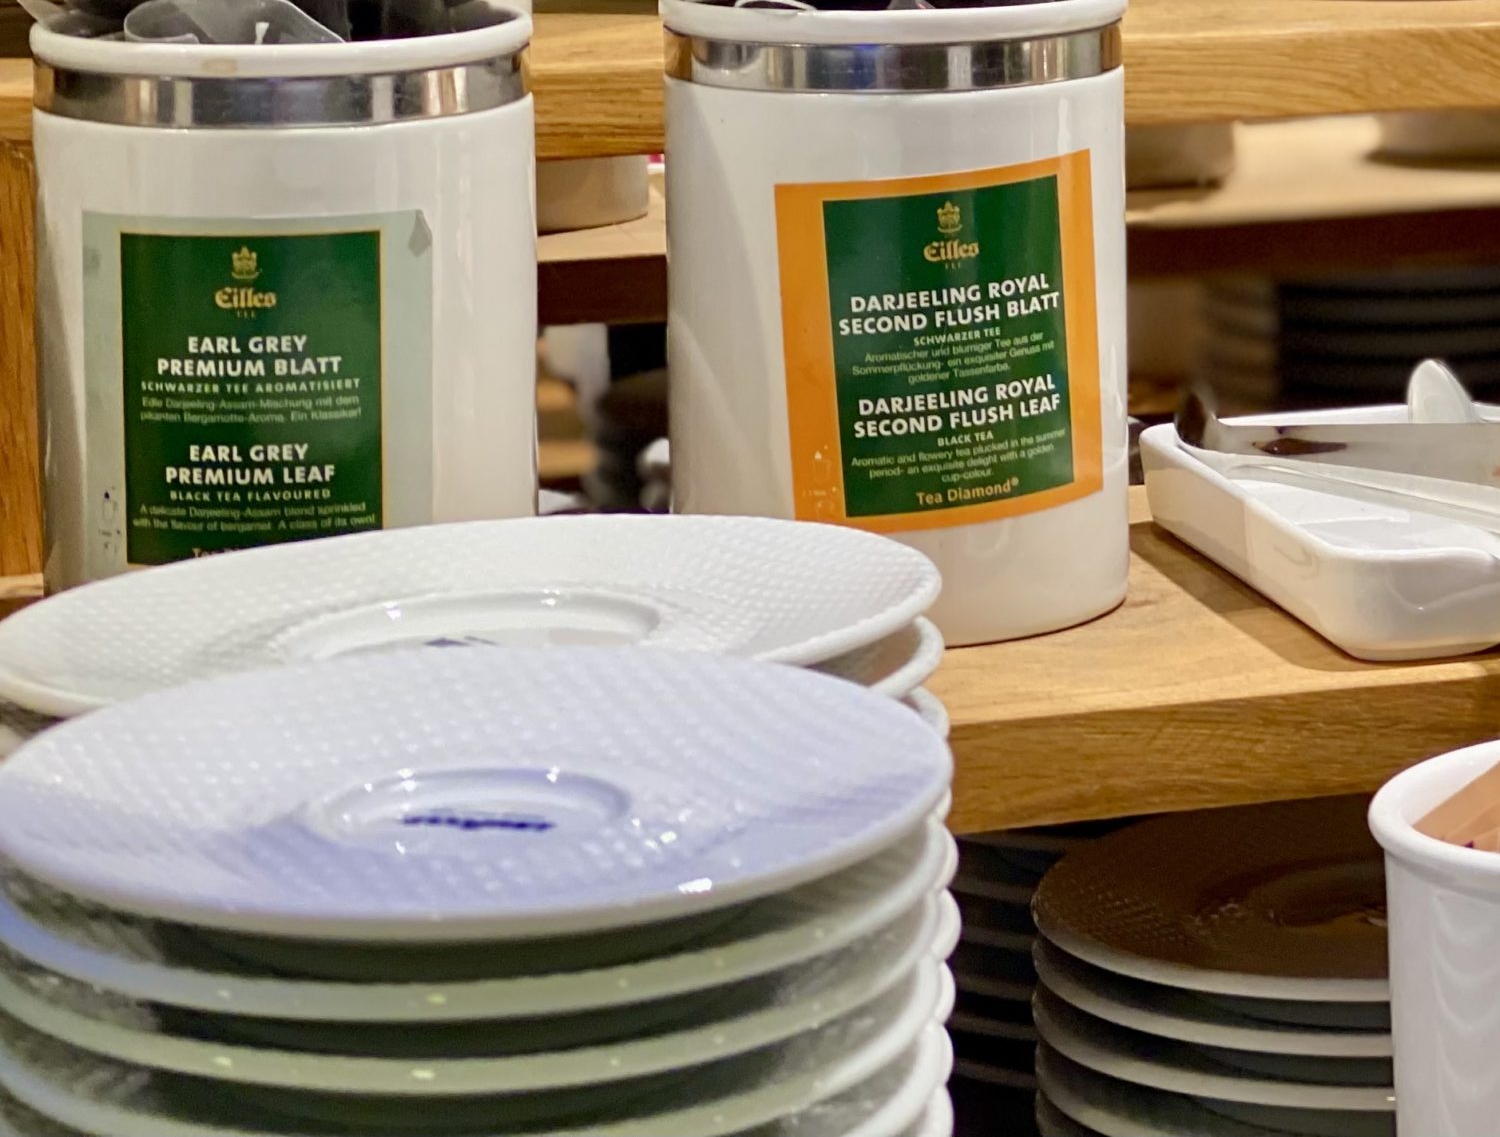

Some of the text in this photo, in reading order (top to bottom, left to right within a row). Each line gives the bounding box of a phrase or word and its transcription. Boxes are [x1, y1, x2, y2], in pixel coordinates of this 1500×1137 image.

[923, 239, 980, 262] Eilles
[214, 287, 277, 309] Eilles
[850, 273, 1049, 313] DARJEELING ROYAL
[839, 292, 1060, 336] SECOND FLUSH BLATT
[187, 334, 308, 354] EARL GREY
[913, 327, 1001, 347] SCHWARZER TEE
[157, 356, 342, 377] PREMIUM BLATT
[140, 378, 361, 394] SCHWARZER TEE AROMATISIERT
[858, 374, 1056, 416] DARJEELING ROYAL
[854, 394, 1061, 439] SECOND FLUSH LEAF
[937, 430, 994, 447] BLACK TEA
[189, 443, 309, 463] EARL GREY
[165, 464, 335, 485] PREMIUM LEAF
[169, 489, 332, 503] BLACK TEA FLAVOURED
[916, 489, 943, 506] Tea
